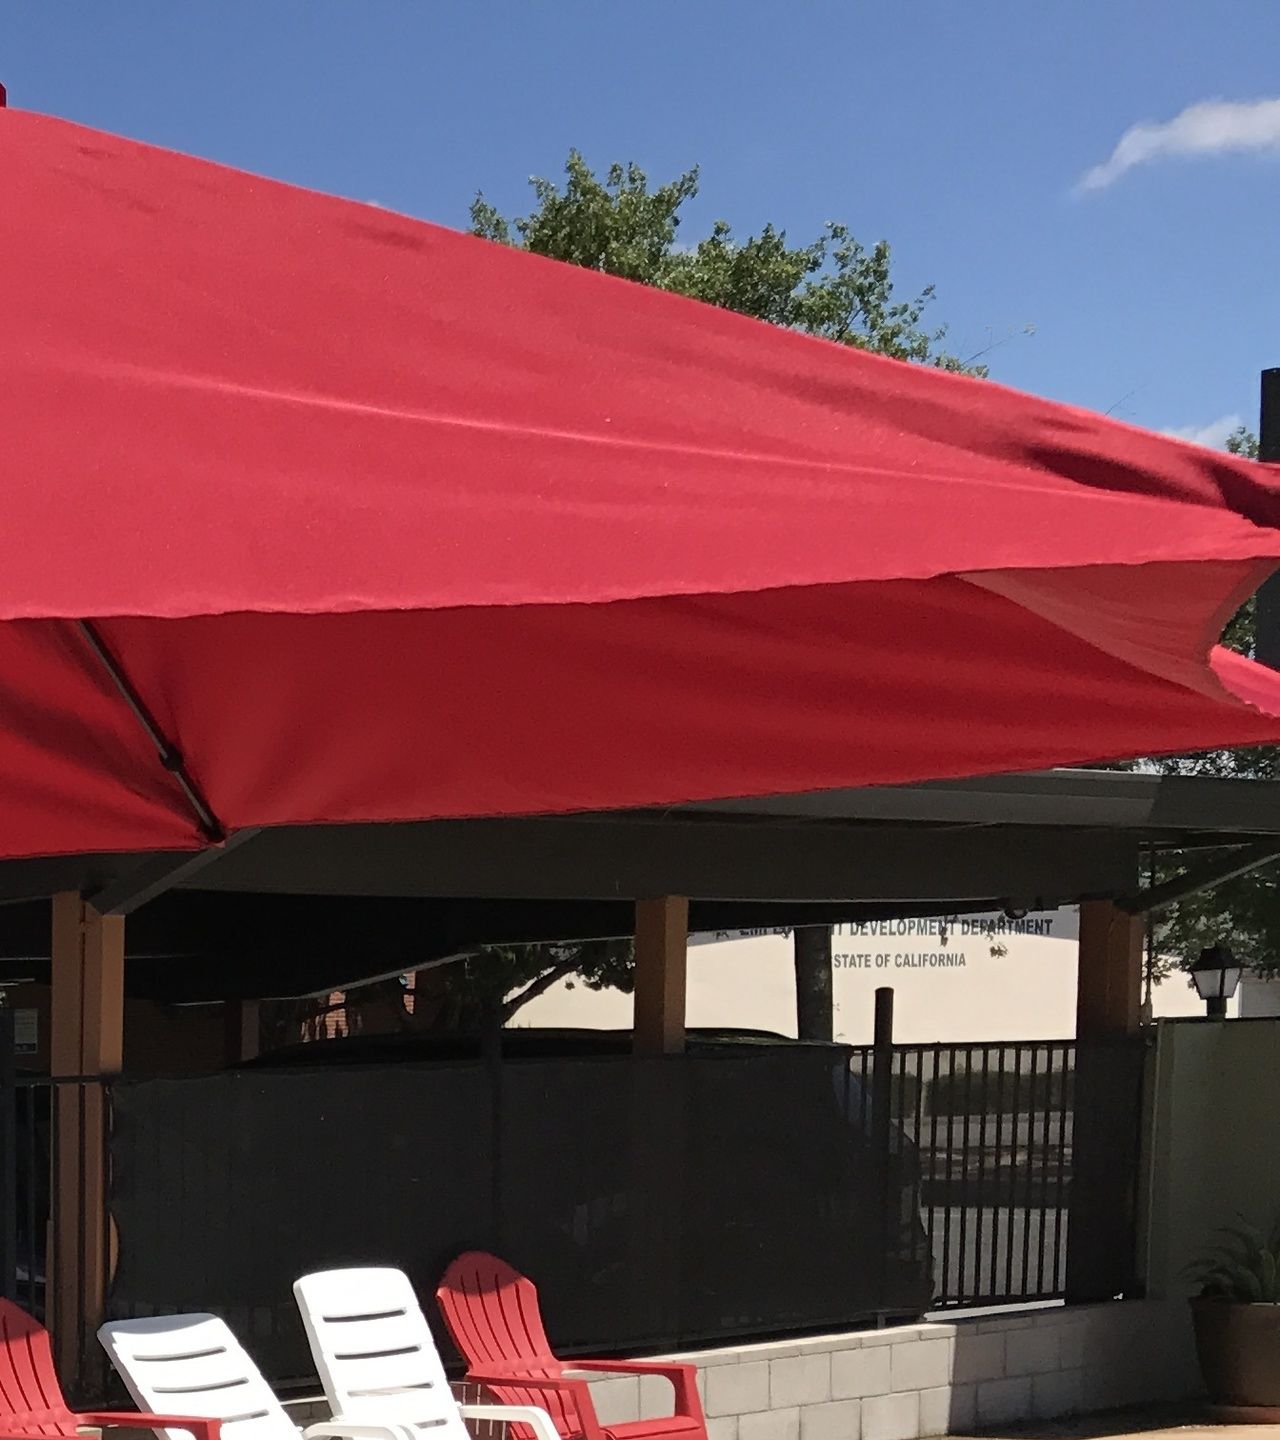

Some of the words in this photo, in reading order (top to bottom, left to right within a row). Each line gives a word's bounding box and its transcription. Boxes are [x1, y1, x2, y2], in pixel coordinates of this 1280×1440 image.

[850, 919, 955, 936] DEVELOPMENT
[961, 919, 1053, 936] DEPARTMENT
[834, 954, 871, 968] STATE
[875, 953, 891, 968] OF
[895, 952, 966, 968] CALIFORNIA
